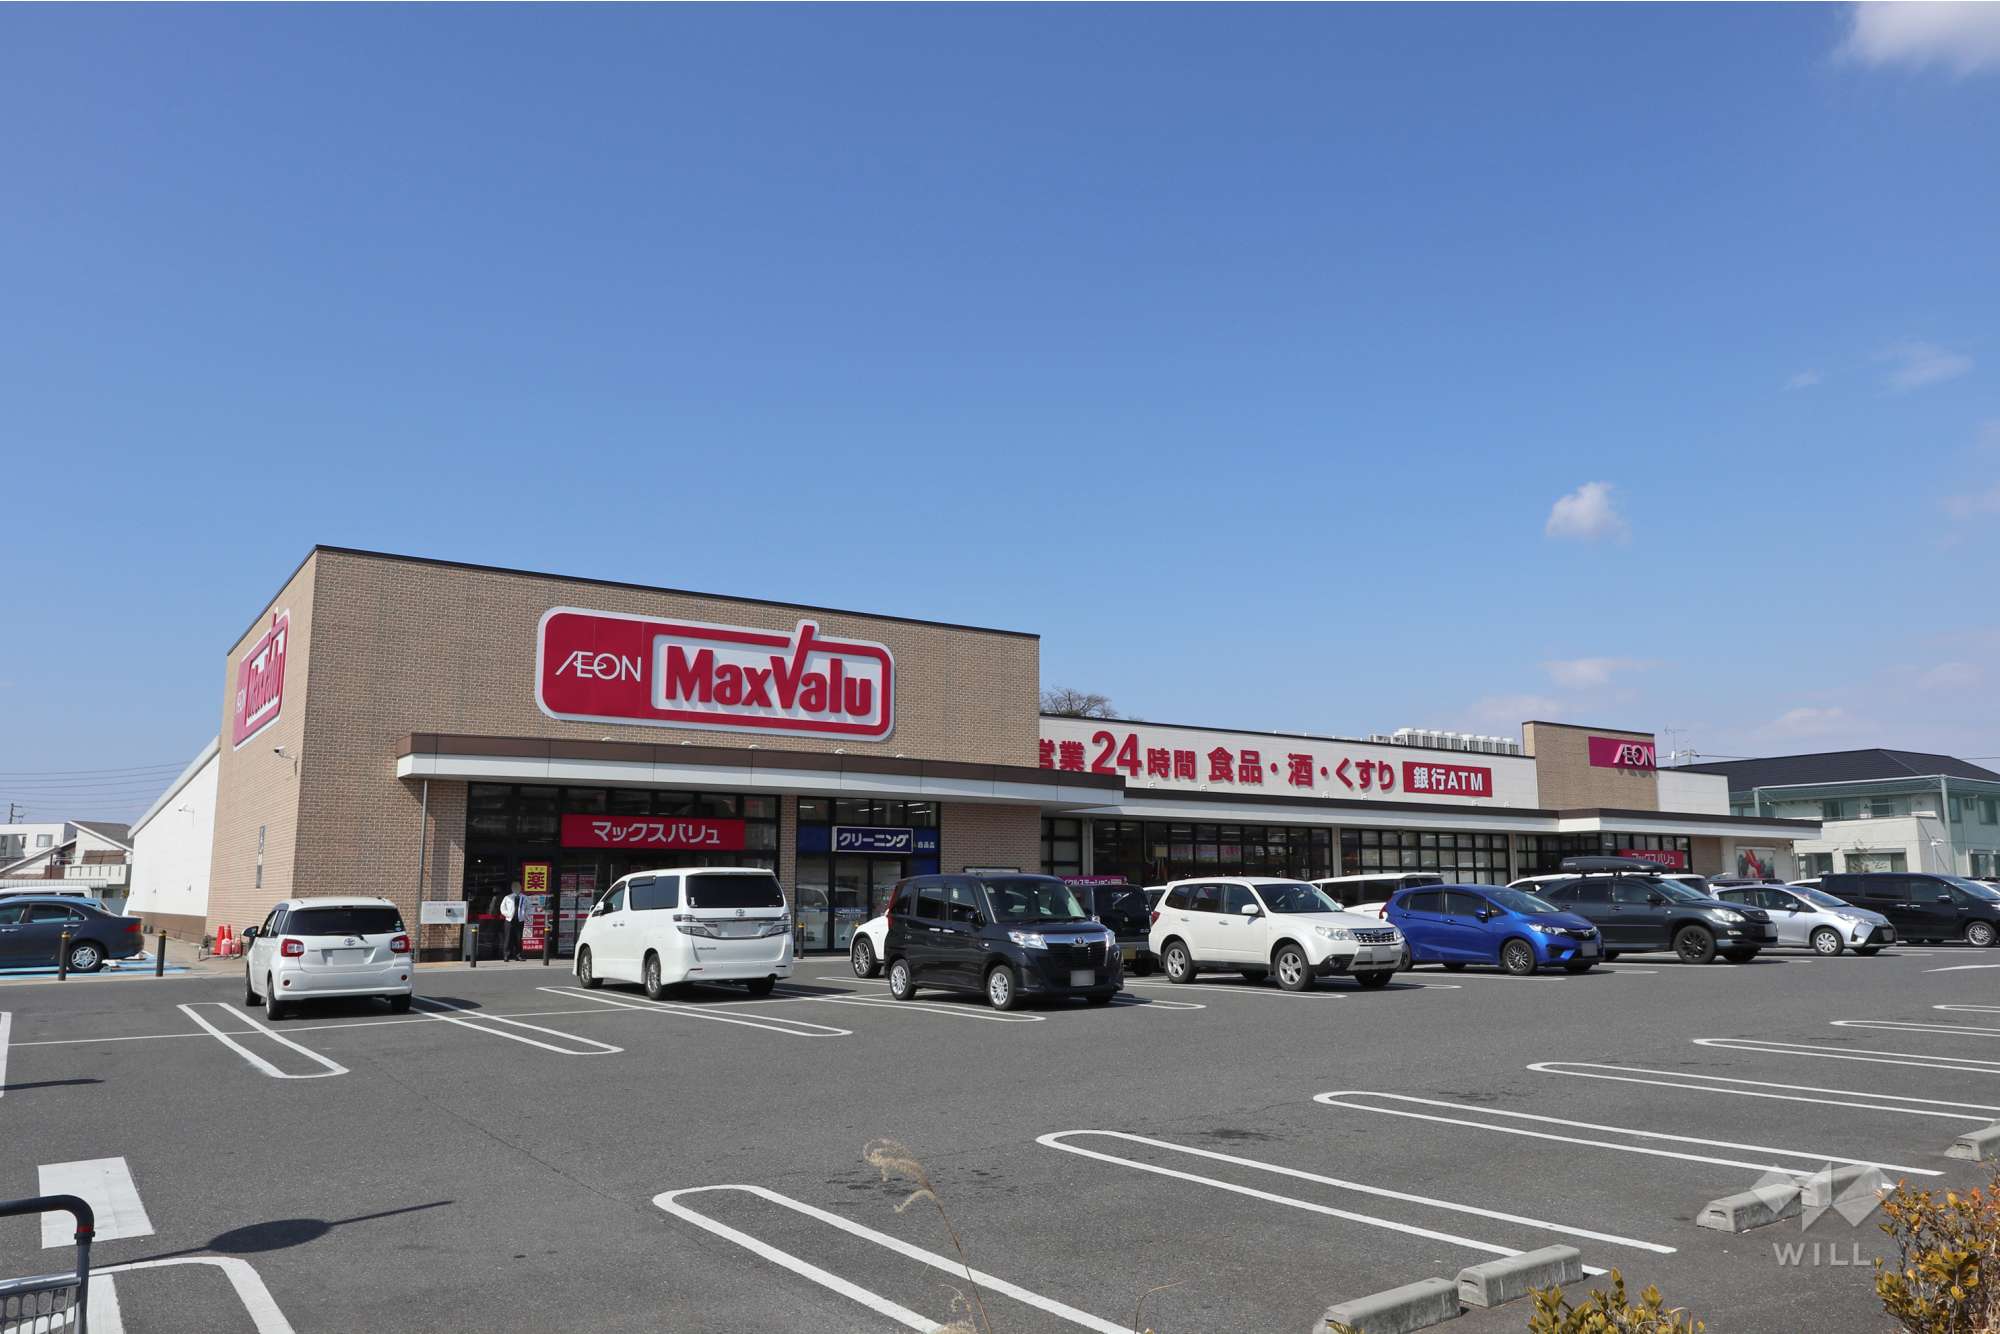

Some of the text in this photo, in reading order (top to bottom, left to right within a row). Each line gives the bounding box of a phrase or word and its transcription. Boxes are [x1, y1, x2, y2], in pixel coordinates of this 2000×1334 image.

[665, 625, 871, 717] MaxValu
[1413, 766, 1484, 791] 銀行ATM
[592, 820, 720, 844] マックスバリュ
[839, 833, 909, 848] クリーニング
